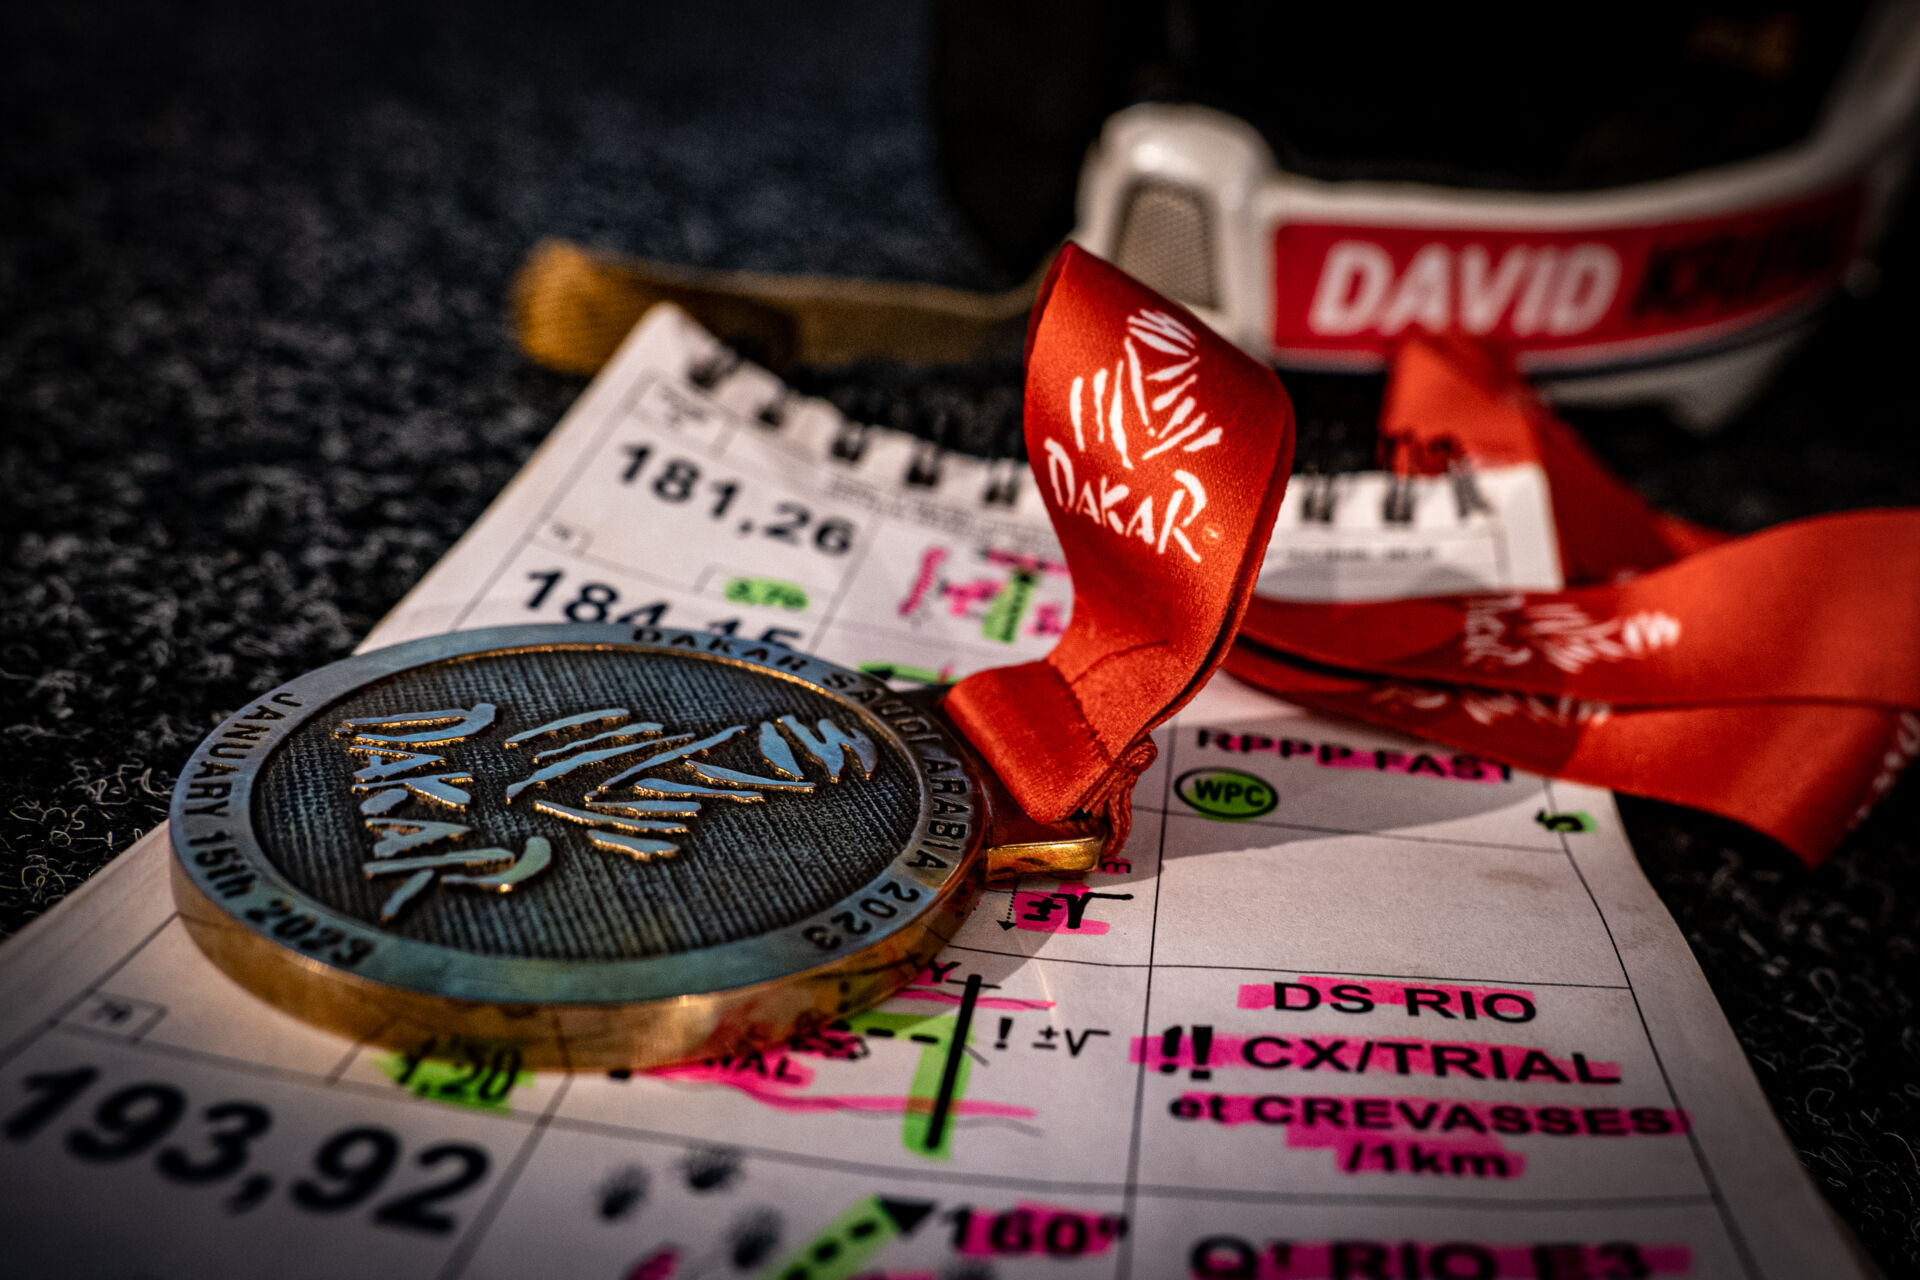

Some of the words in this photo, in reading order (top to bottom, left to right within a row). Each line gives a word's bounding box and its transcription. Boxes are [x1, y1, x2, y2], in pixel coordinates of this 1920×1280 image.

[1308, 239, 1622, 337] DAVID
[617, 438, 856, 558] 181,26
[1044, 436, 1208, 564] DAKAR
[632, 628, 808, 671] DAKAR
[823, 673, 943, 744] SAUDI
[185, 691, 300, 819] JANUARY
[334, 702, 553, 923] DAKAR
[906, 756, 971, 873] ARABIA
[1194, 773, 1265, 808] WPC
[188, 830, 258, 899] 15th
[245, 898, 377, 967] 2023
[801, 881, 920, 951] 2023
[1273, 981, 1376, 1014] DS
[1404, 986, 1538, 1024] RIO
[1240, 1035, 1623, 1085] CX/TRIAL
[3, 1064, 495, 1237] 193,92
[1168, 1096, 1225, 1123] et
[1251, 1095, 1674, 1137] CREVASSES
